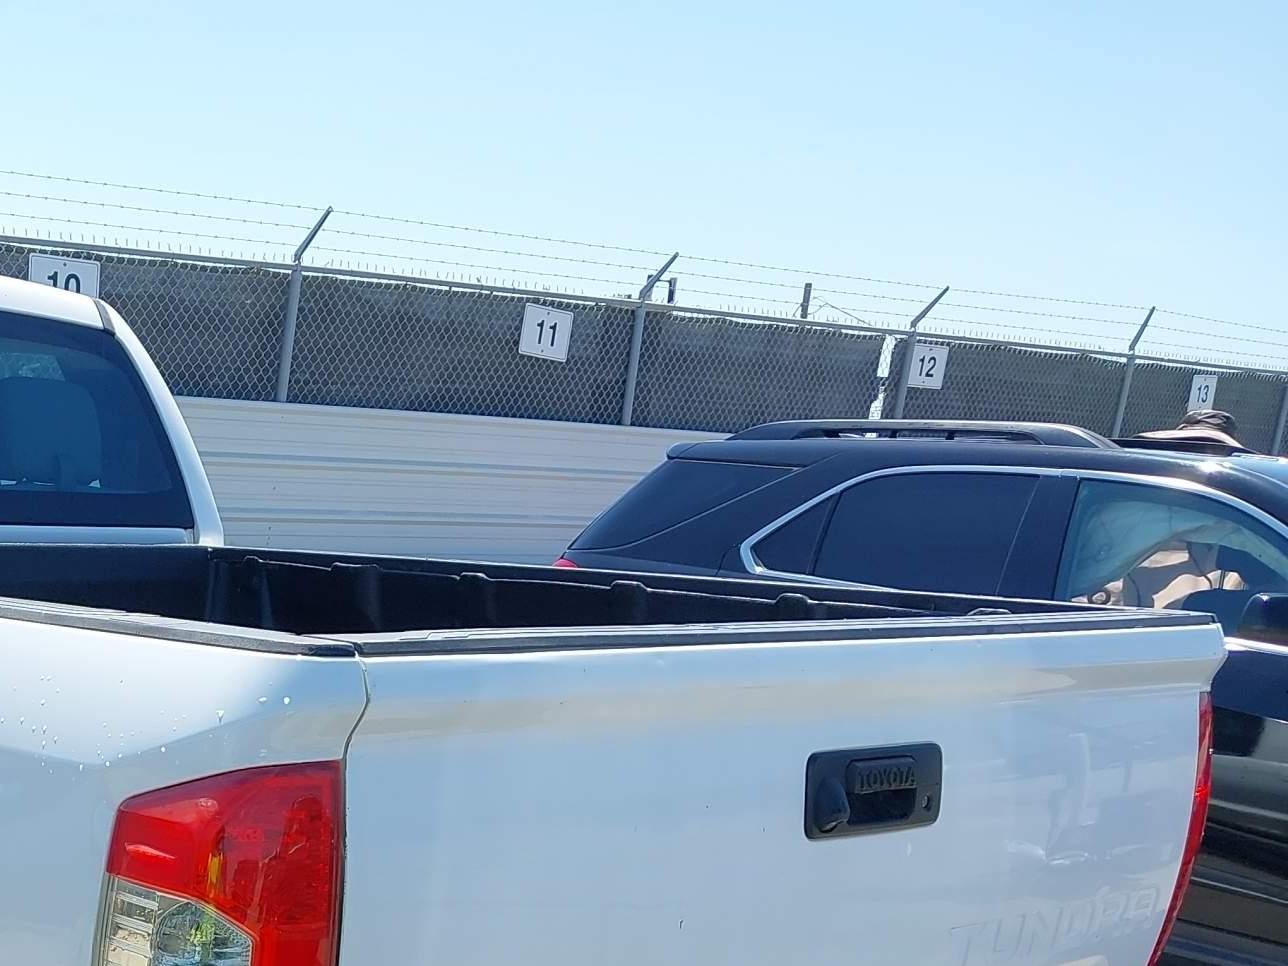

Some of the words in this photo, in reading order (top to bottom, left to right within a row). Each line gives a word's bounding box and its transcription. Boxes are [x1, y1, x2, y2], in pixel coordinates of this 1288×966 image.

[536, 319, 558, 347] 11
[918, 354, 937, 378] 12
[1196, 384, 1210, 403] 13
[855, 766, 917, 793] TOYOTA
